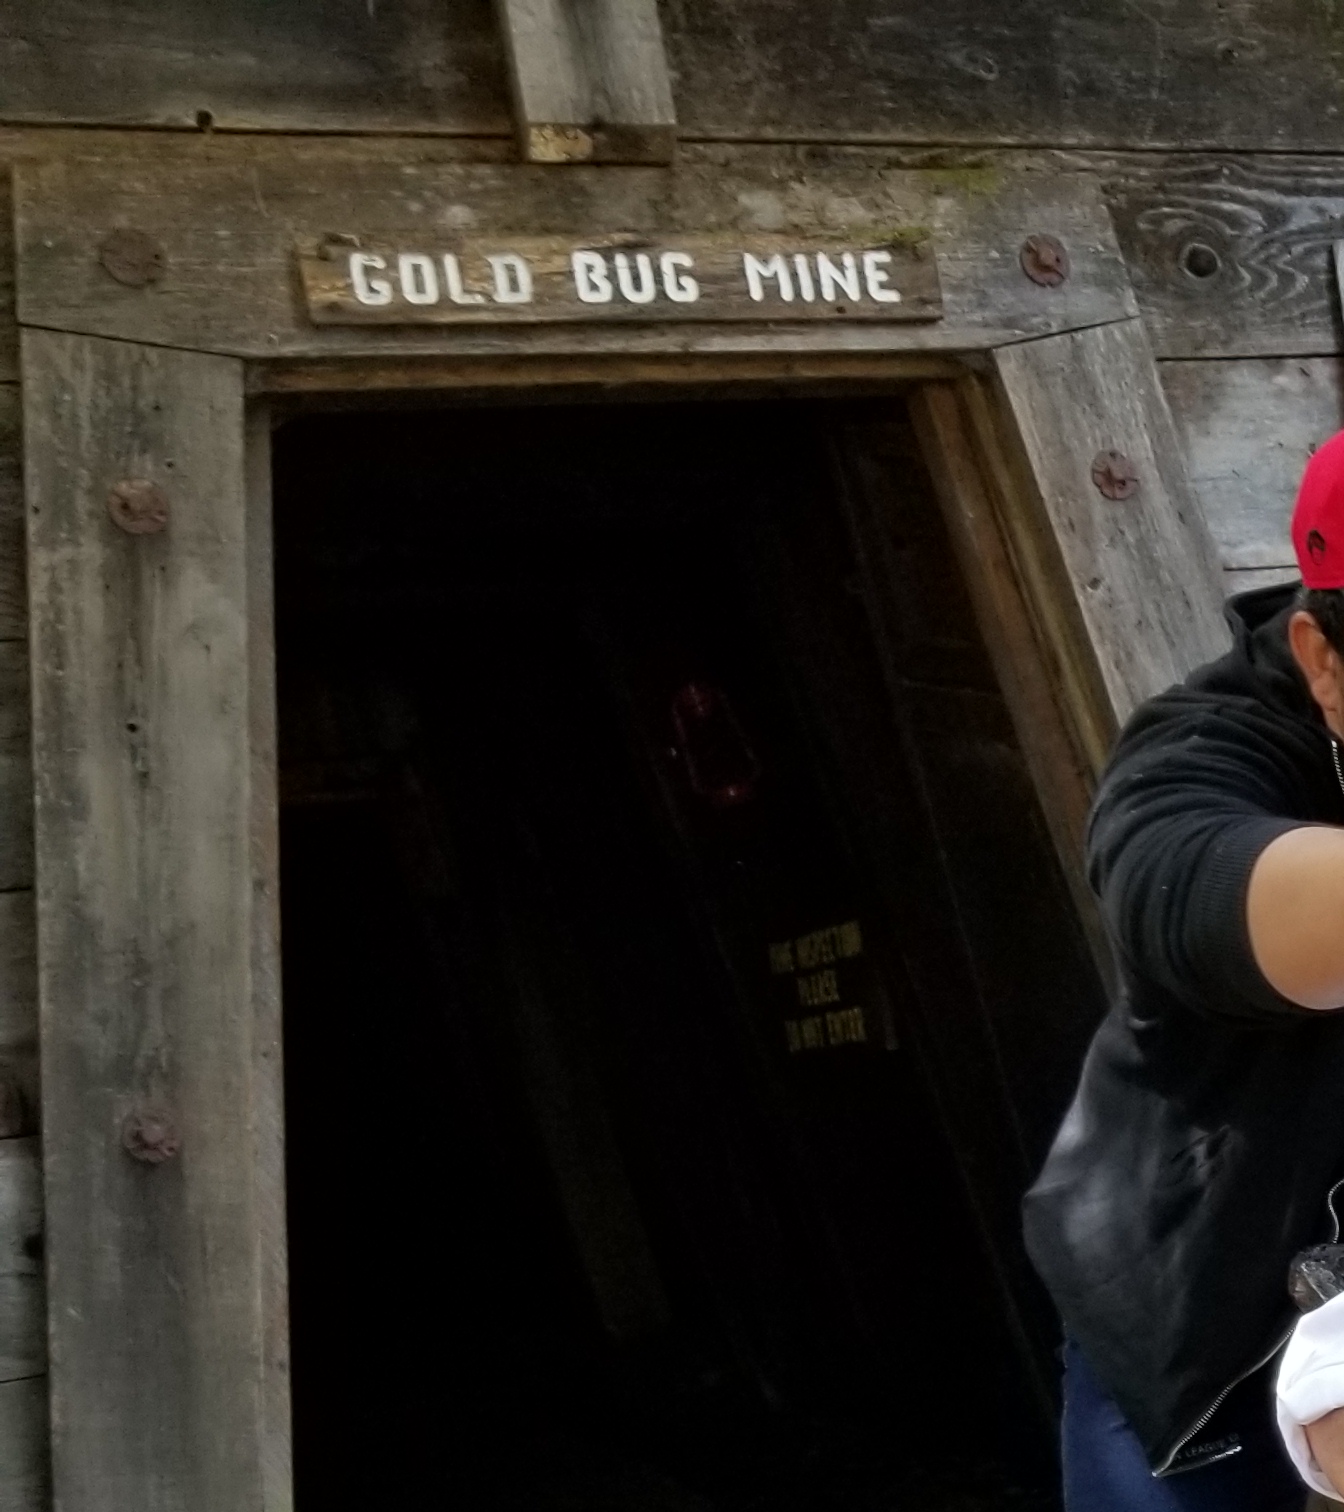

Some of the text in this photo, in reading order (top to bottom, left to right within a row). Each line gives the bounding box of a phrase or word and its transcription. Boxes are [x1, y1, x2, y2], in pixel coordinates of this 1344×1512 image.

[349, 249, 902, 305] GOLD BUG MINE
